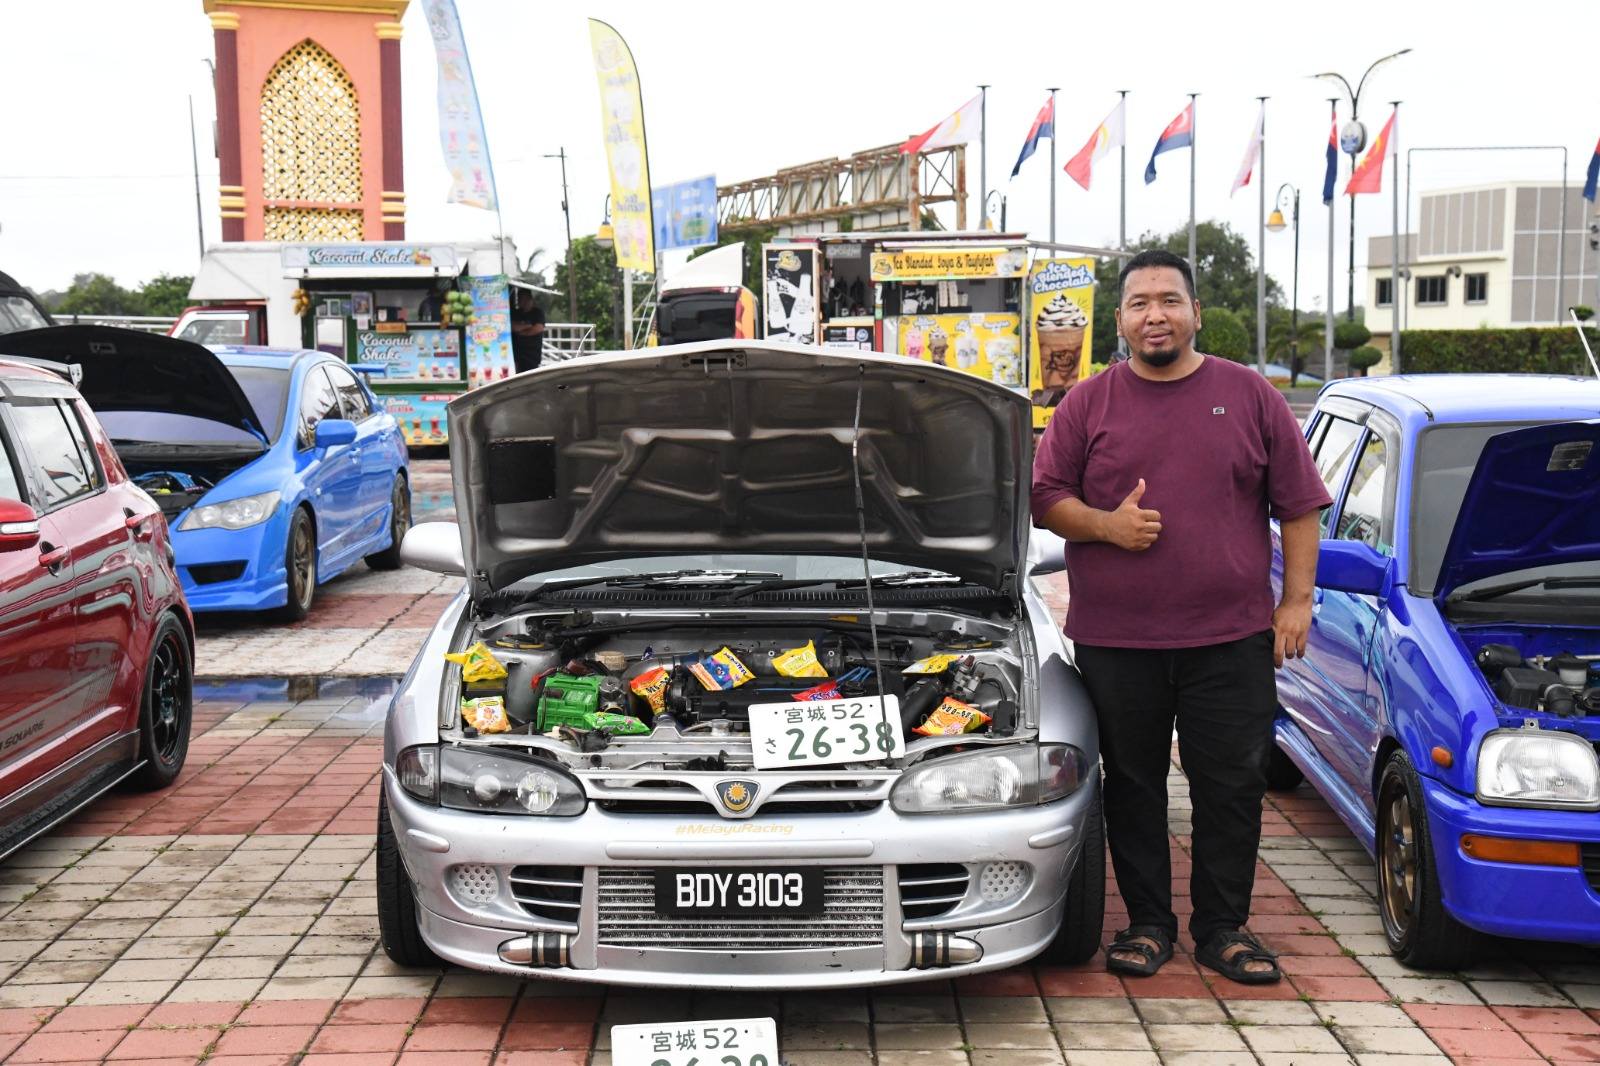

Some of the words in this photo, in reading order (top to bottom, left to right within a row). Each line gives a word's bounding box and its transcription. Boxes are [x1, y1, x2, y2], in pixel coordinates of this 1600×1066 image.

[309, 248, 367, 265] Coconut
[372, 248, 411, 265] Shake
[893, 255, 904, 270] Ice
[905, 255, 934, 270] Blended
[937, 254, 955, 273] Soya
[956, 255, 964, 269] &
[1037, 265, 1087, 282] Blended
[1046, 262, 1068, 273] Ice
[1034, 275, 1091, 293] Chocolate
[360, 333, 413, 346] Coconut
[361, 347, 401, 361] Shake
[784, 707, 826, 724] 宮城
[831, 703, 865, 720] 52
[765, 738, 777, 754] さ
[785, 721, 896, 761] 26-38
[675, 823, 794, 836] #MelayuRacing
[676, 873, 733, 908] BDY
[737, 872, 803, 907] 3103
[651, 1029, 697, 1053] 宮城
[703, 1027, 740, 1050] 52
